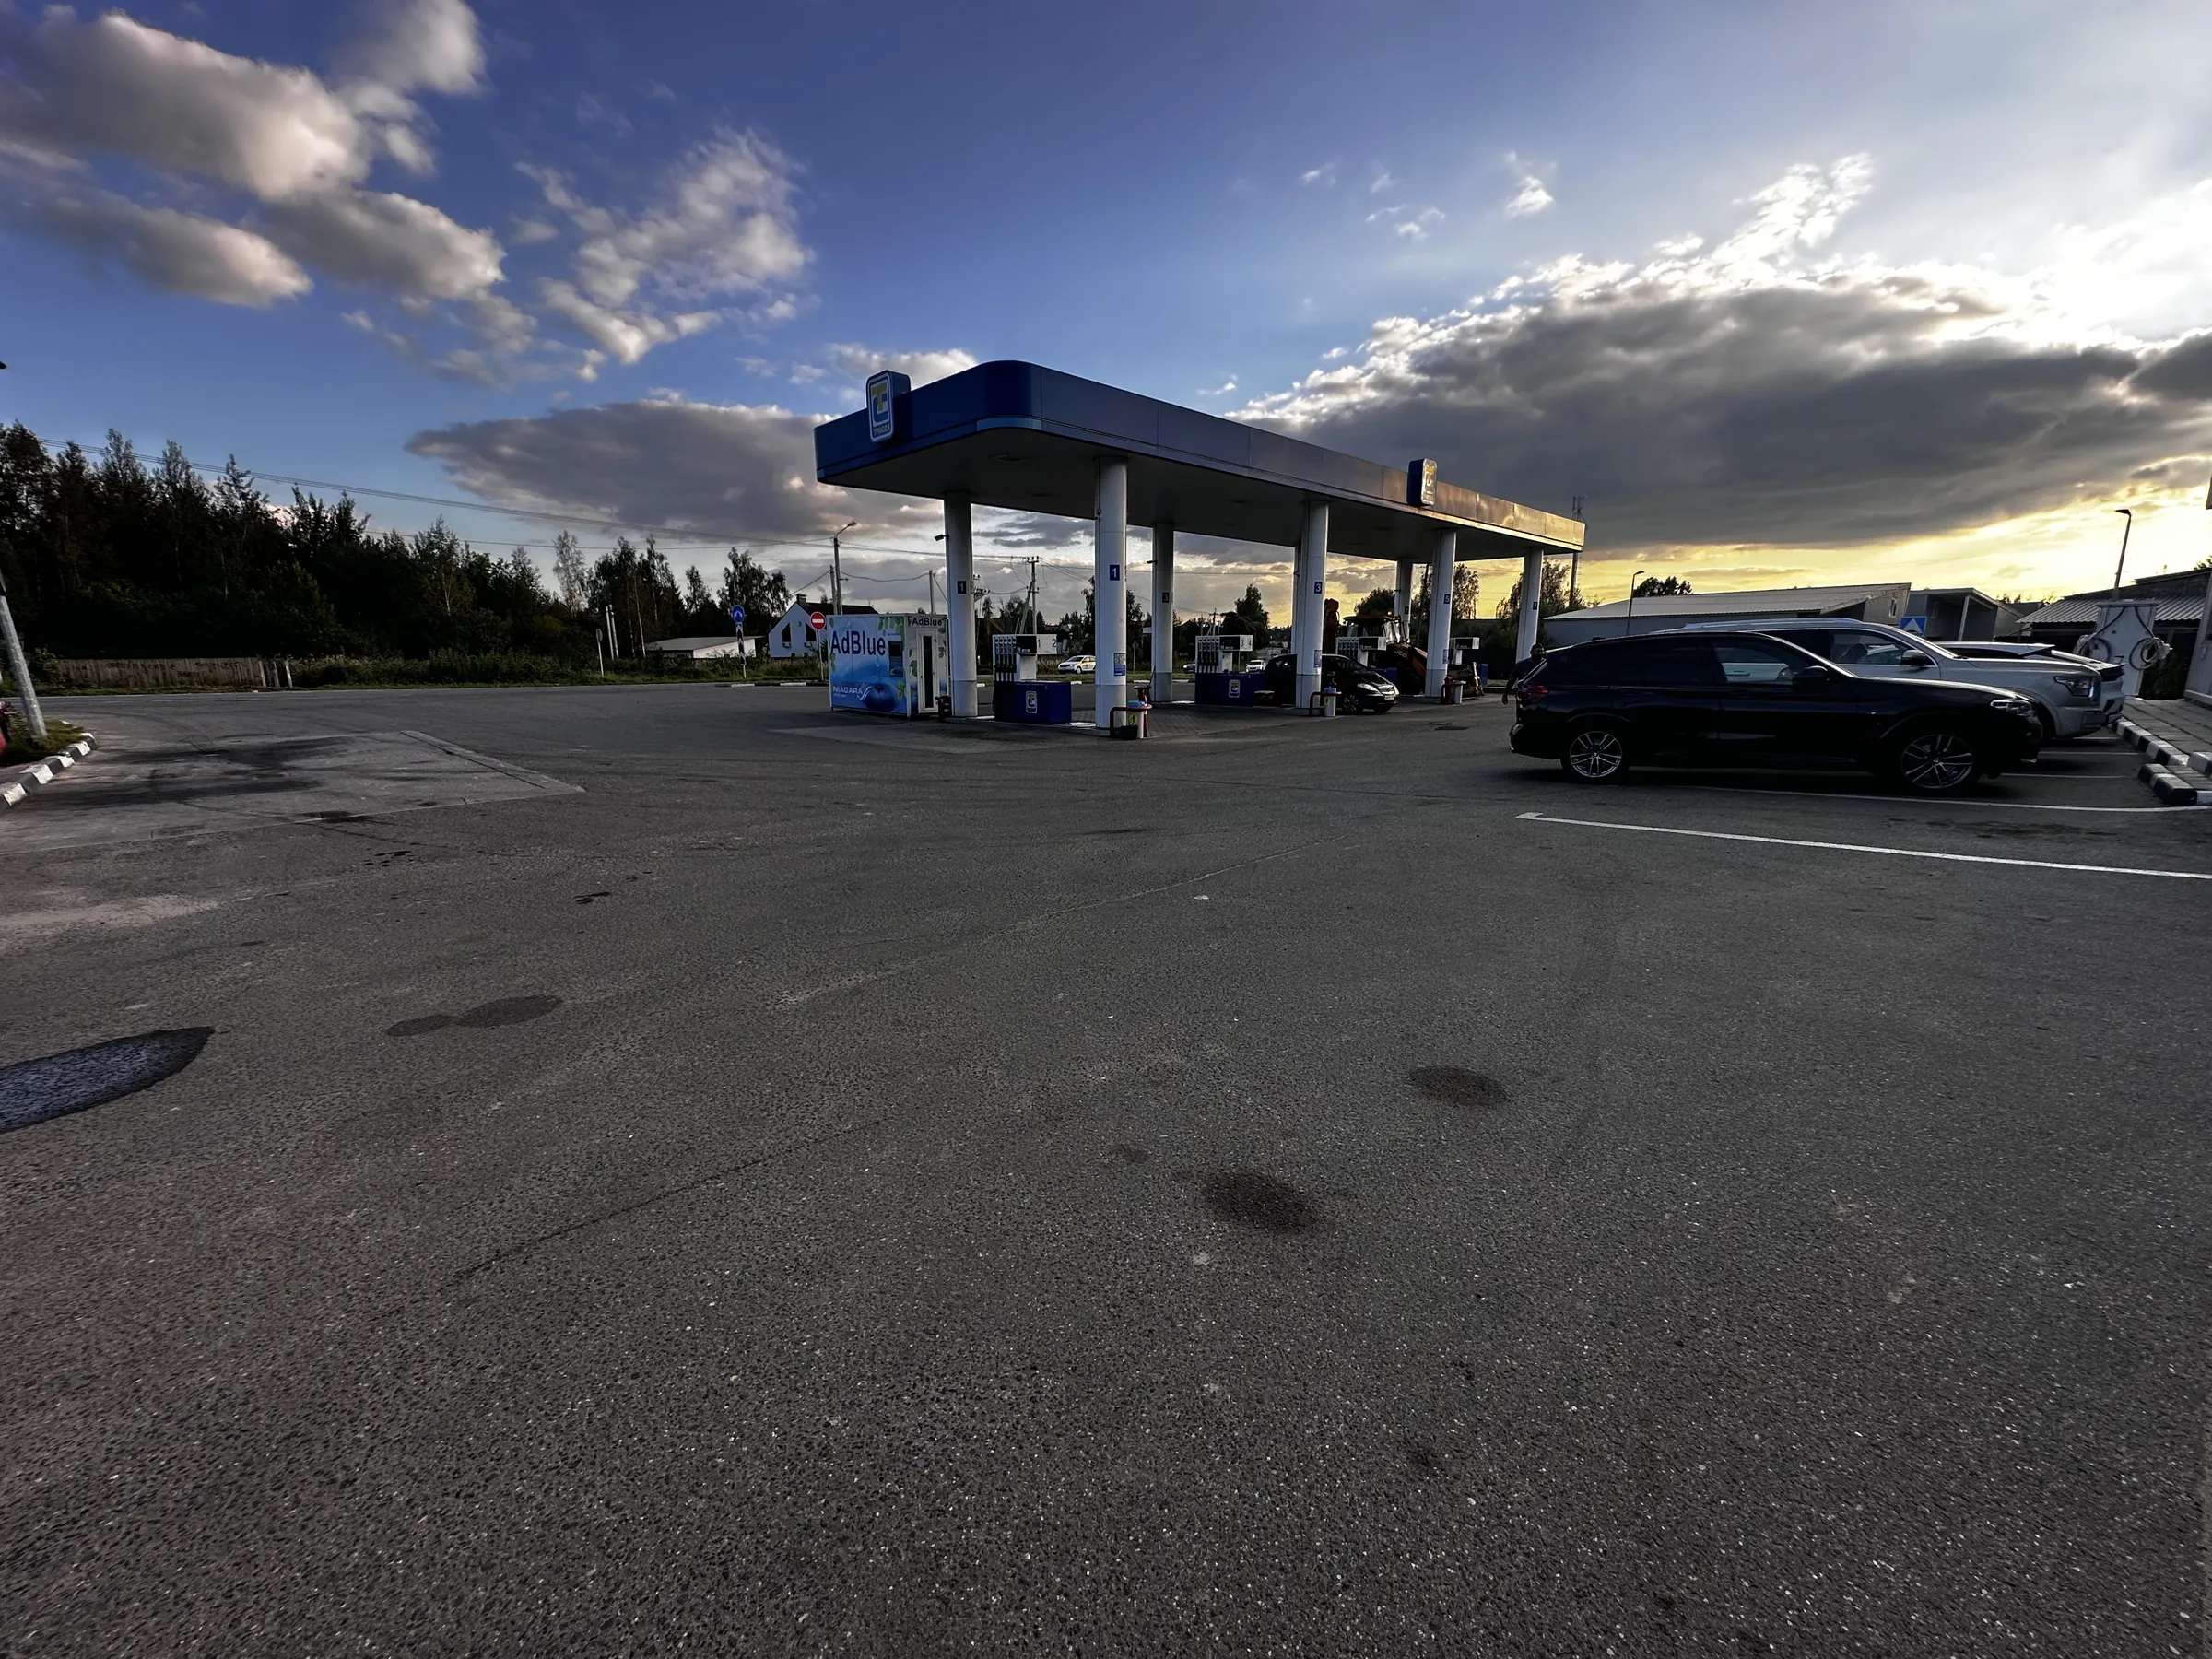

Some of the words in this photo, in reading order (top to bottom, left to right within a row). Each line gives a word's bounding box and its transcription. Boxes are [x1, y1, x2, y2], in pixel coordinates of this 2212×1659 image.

[912, 617, 942, 626] AdBlue
[830, 630, 886, 656] AdBlue
[833, 686, 863, 694] NIAGARA
